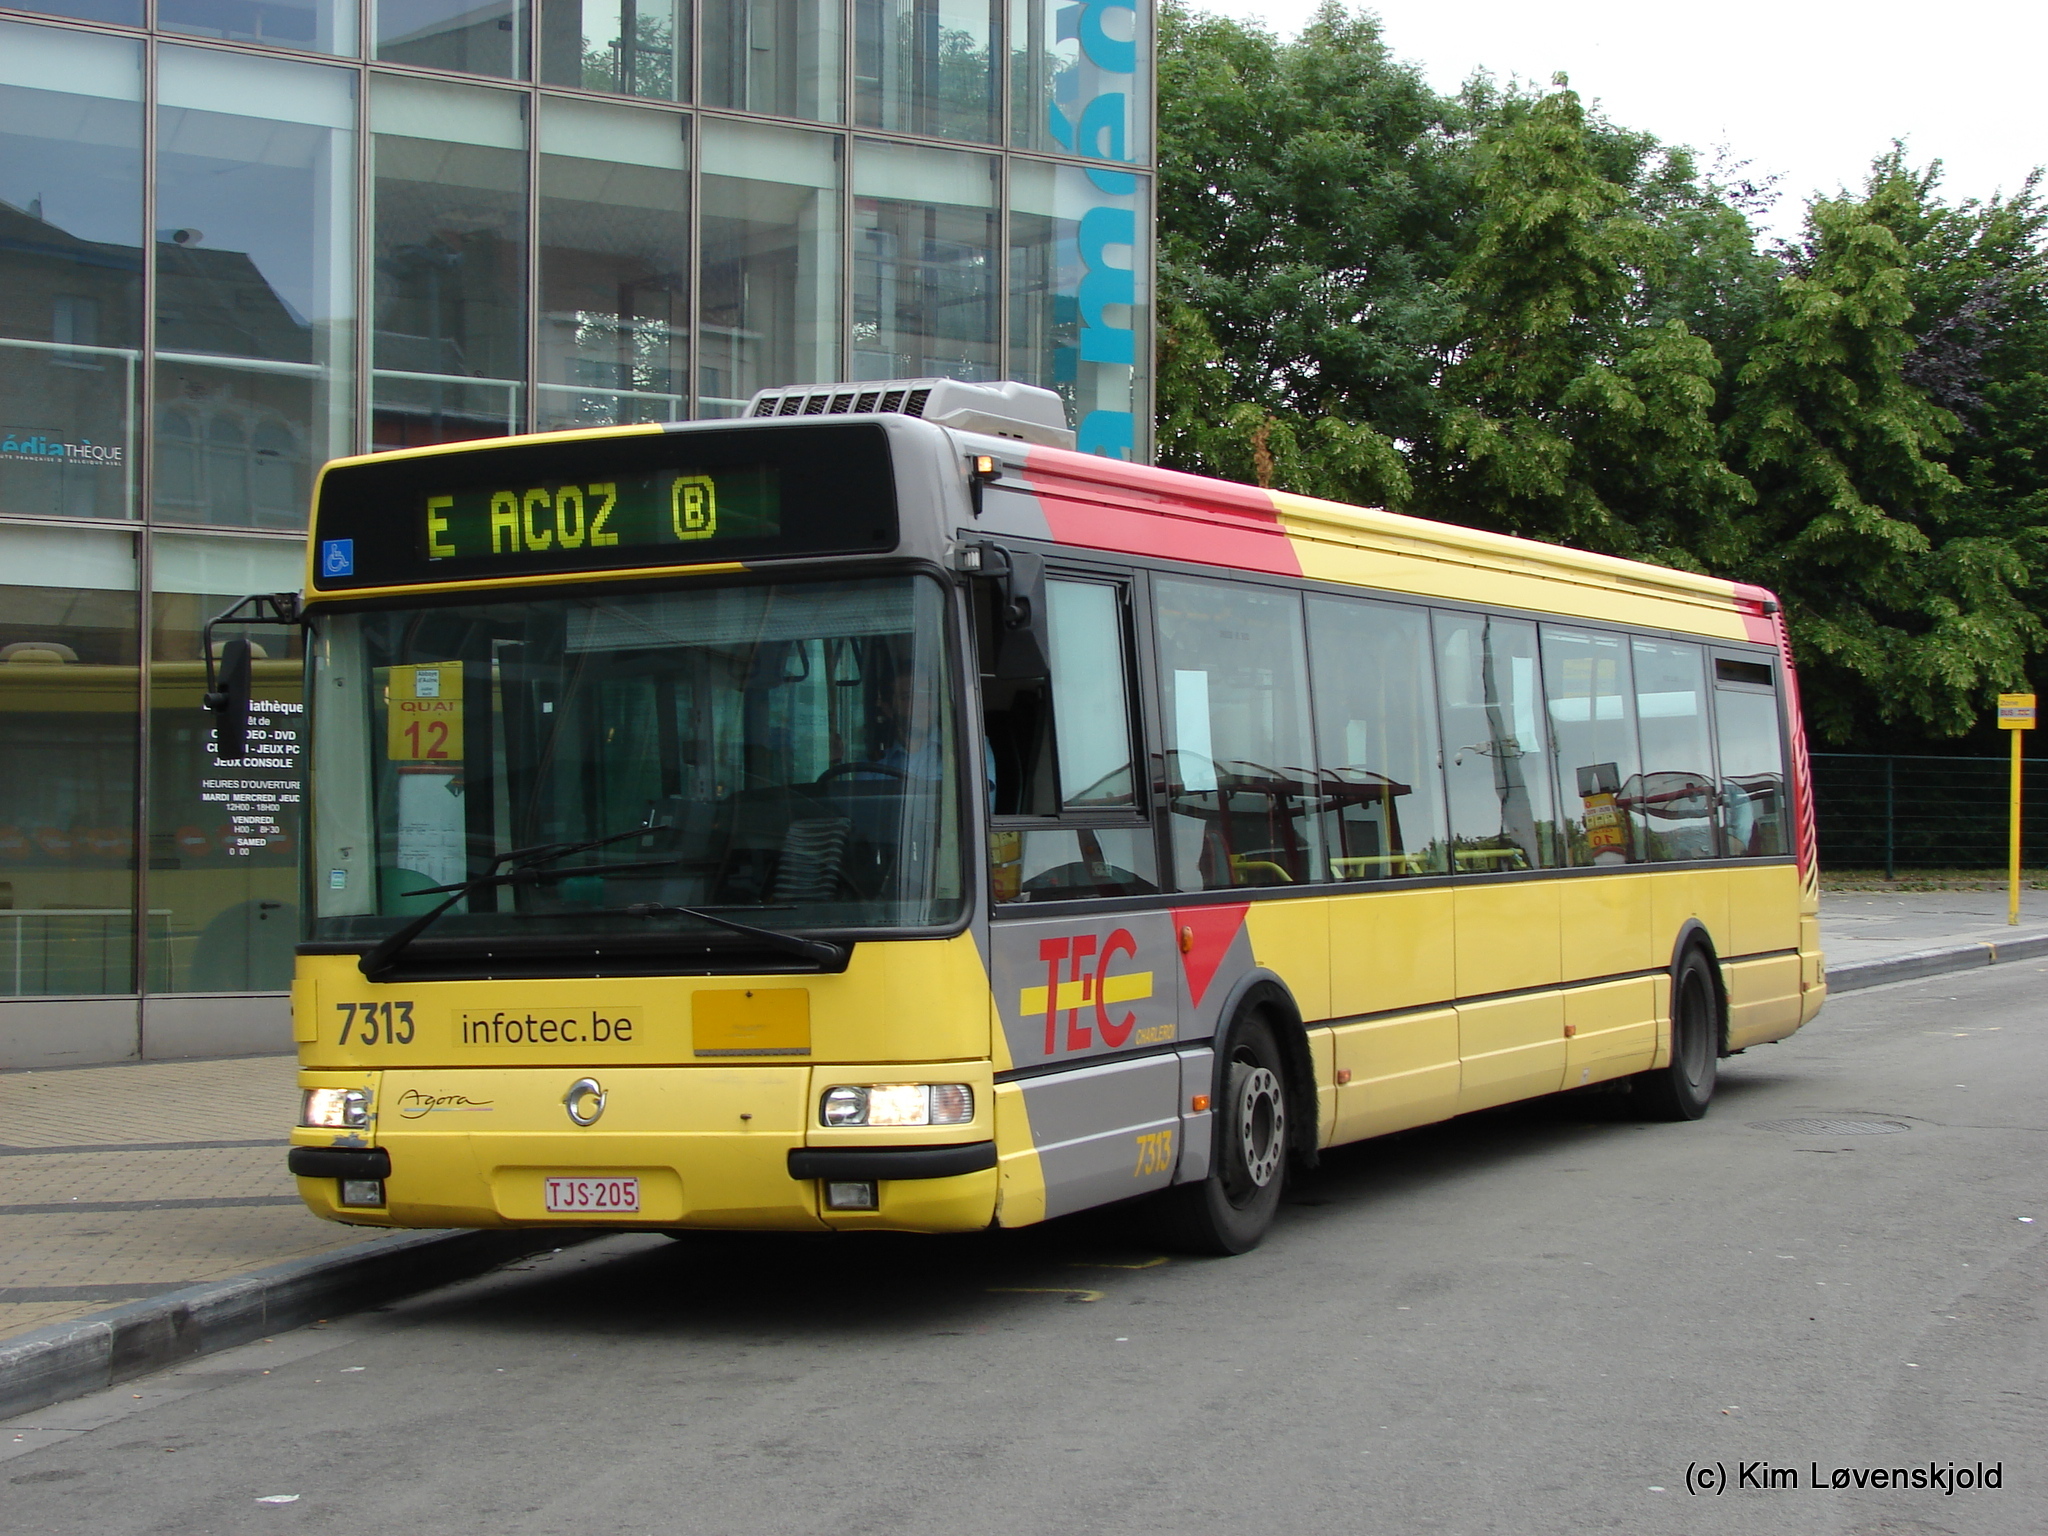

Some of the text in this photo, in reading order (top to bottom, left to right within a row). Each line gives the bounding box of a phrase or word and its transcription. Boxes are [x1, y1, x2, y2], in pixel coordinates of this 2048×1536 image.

[427, 495, 456, 558] E
[490, 482, 619, 554] ACOZ
[248, 700, 304, 715] iathèque
[401, 701, 454, 712] QUAI
[258, 717, 271, 726] de
[274, 731, 297, 740] DVD
[404, 720, 448, 759] 12
[256, 745, 284, 754] JEUX
[285, 745, 300, 754] PC
[213, 758, 294, 768] JEUX CONSOLE
[202, 780, 240, 789] HEURES
[202, 793, 230, 802] MARDI
[232, 794, 277, 802] MERCREDI
[232, 816, 275, 824] VENDREDI
[1038, 928, 1138, 1055] TEC
[336, 1001, 416, 1046] 7313
[462, 1011, 634, 1045] infotec.be
[1135, 1023, 1176, 1045] CHARLEROI
[397, 1088, 495, 1120] Agora
[1134, 1129, 1173, 1178] 7313
[548, 1181, 637, 1207] TJS-205
